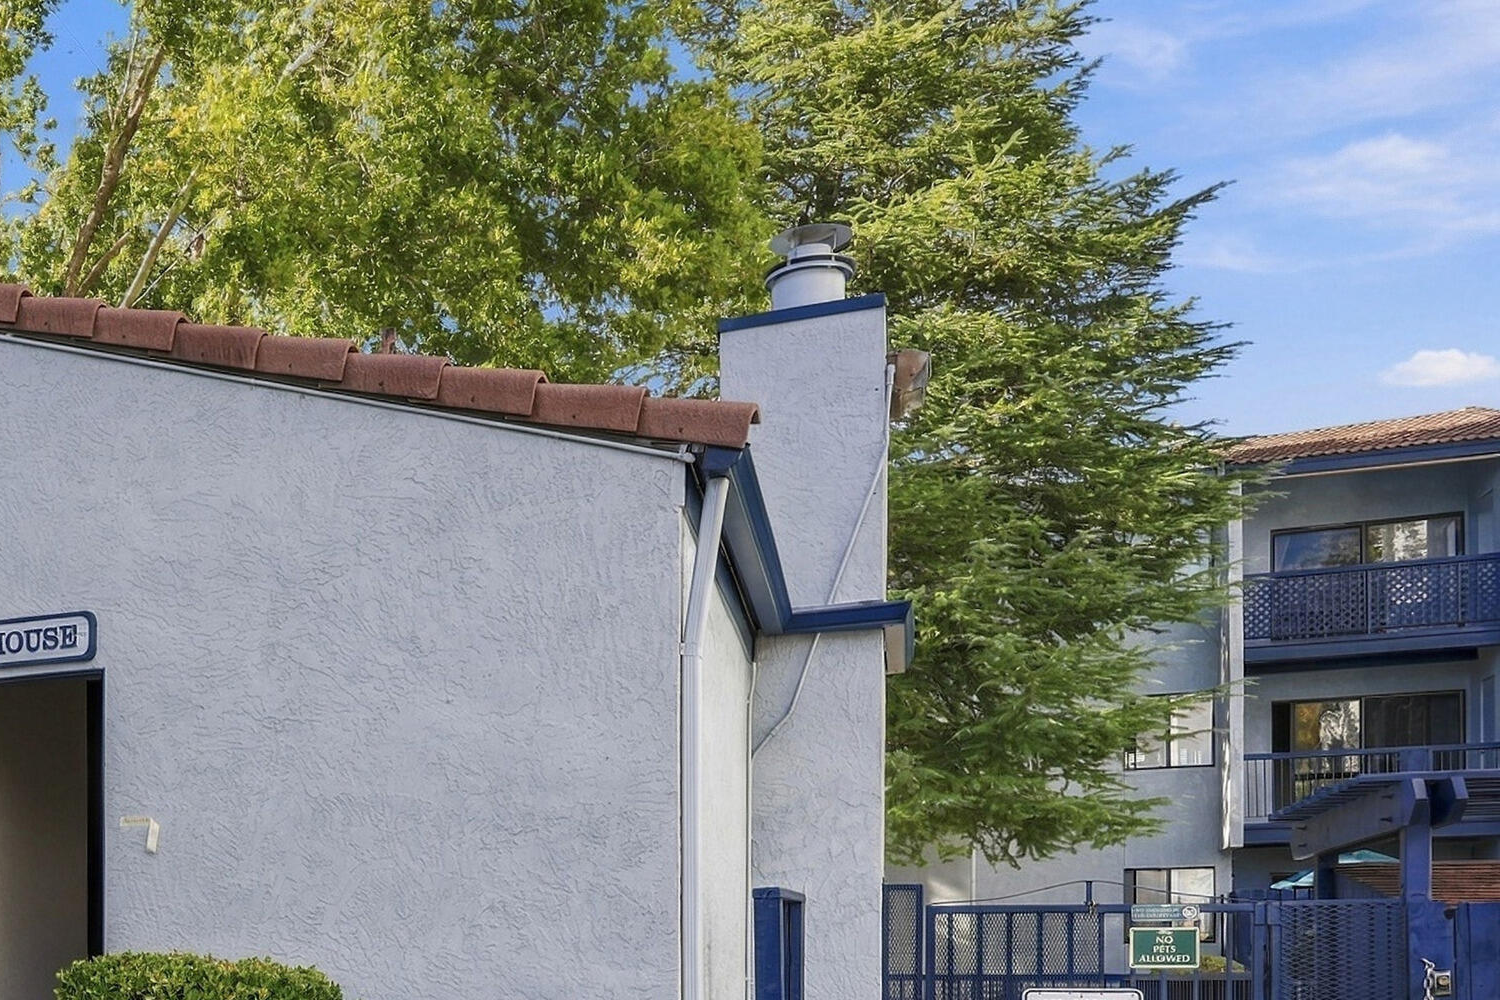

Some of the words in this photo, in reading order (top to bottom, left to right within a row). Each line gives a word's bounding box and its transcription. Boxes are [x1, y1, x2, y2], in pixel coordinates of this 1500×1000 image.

[1155, 935, 1174, 944] NO
[1152, 945, 1177, 953] PETS
[1138, 954, 1191, 963] ALLOWED
